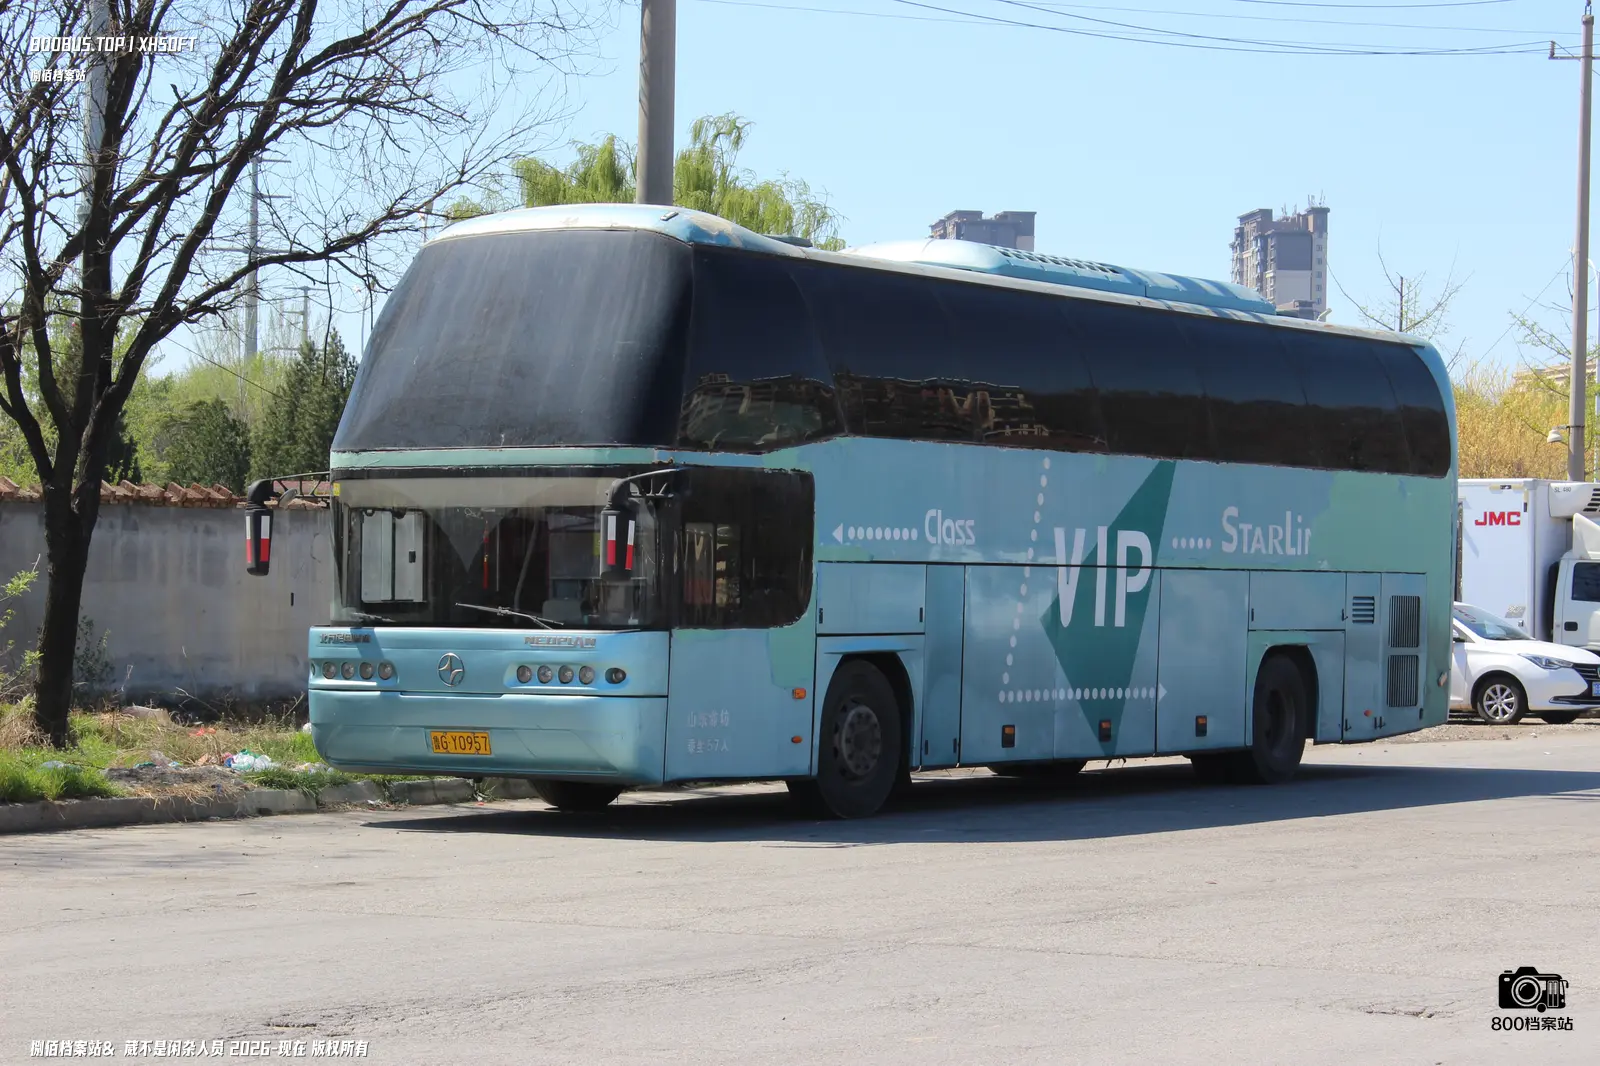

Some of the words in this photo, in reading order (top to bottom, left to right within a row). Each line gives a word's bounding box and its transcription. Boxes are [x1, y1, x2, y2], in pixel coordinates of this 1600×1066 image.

[924, 508, 975, 546] Class
[1475, 511, 1521, 526] JMC
[1053, 525, 1153, 628] VIP
